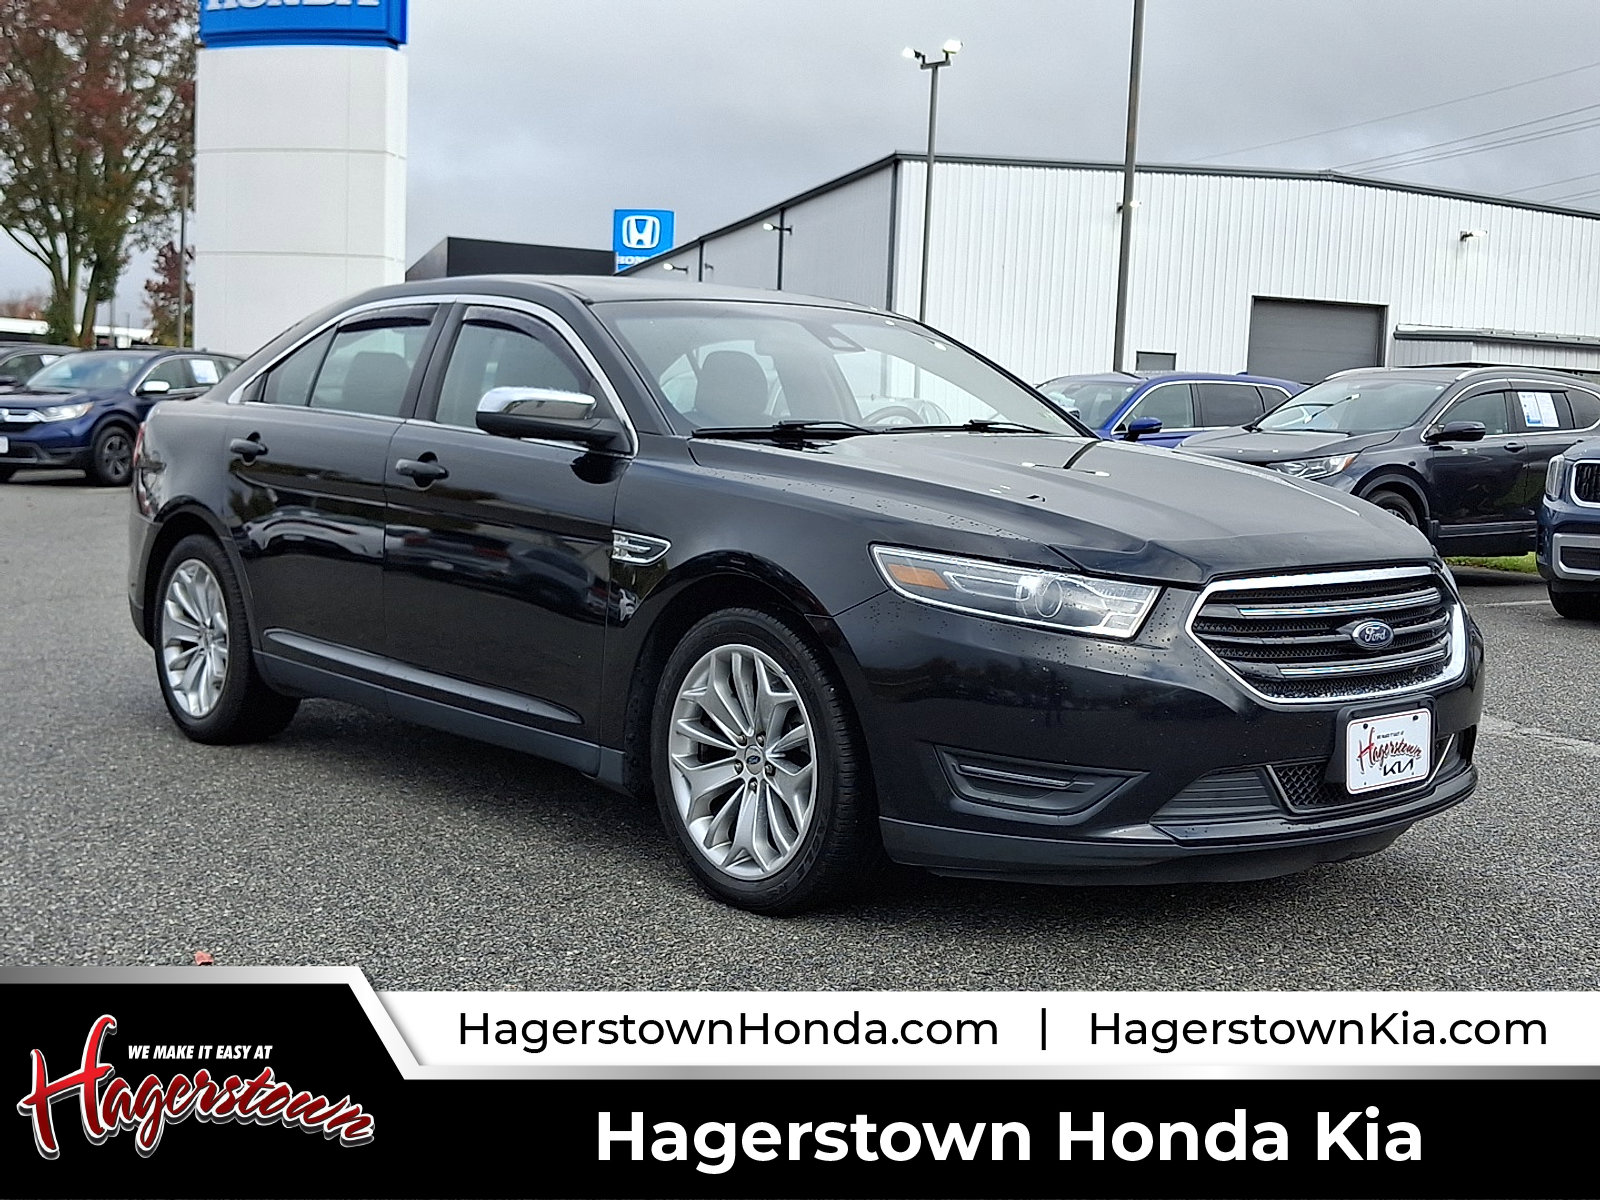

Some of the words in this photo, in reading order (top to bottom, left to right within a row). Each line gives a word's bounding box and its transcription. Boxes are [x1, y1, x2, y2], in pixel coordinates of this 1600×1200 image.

[616, 255, 651, 265] HON
[1364, 626, 1386, 643] Ford
[1356, 726, 1422, 774] Hagerstown
[1383, 758, 1414, 776] KIA
